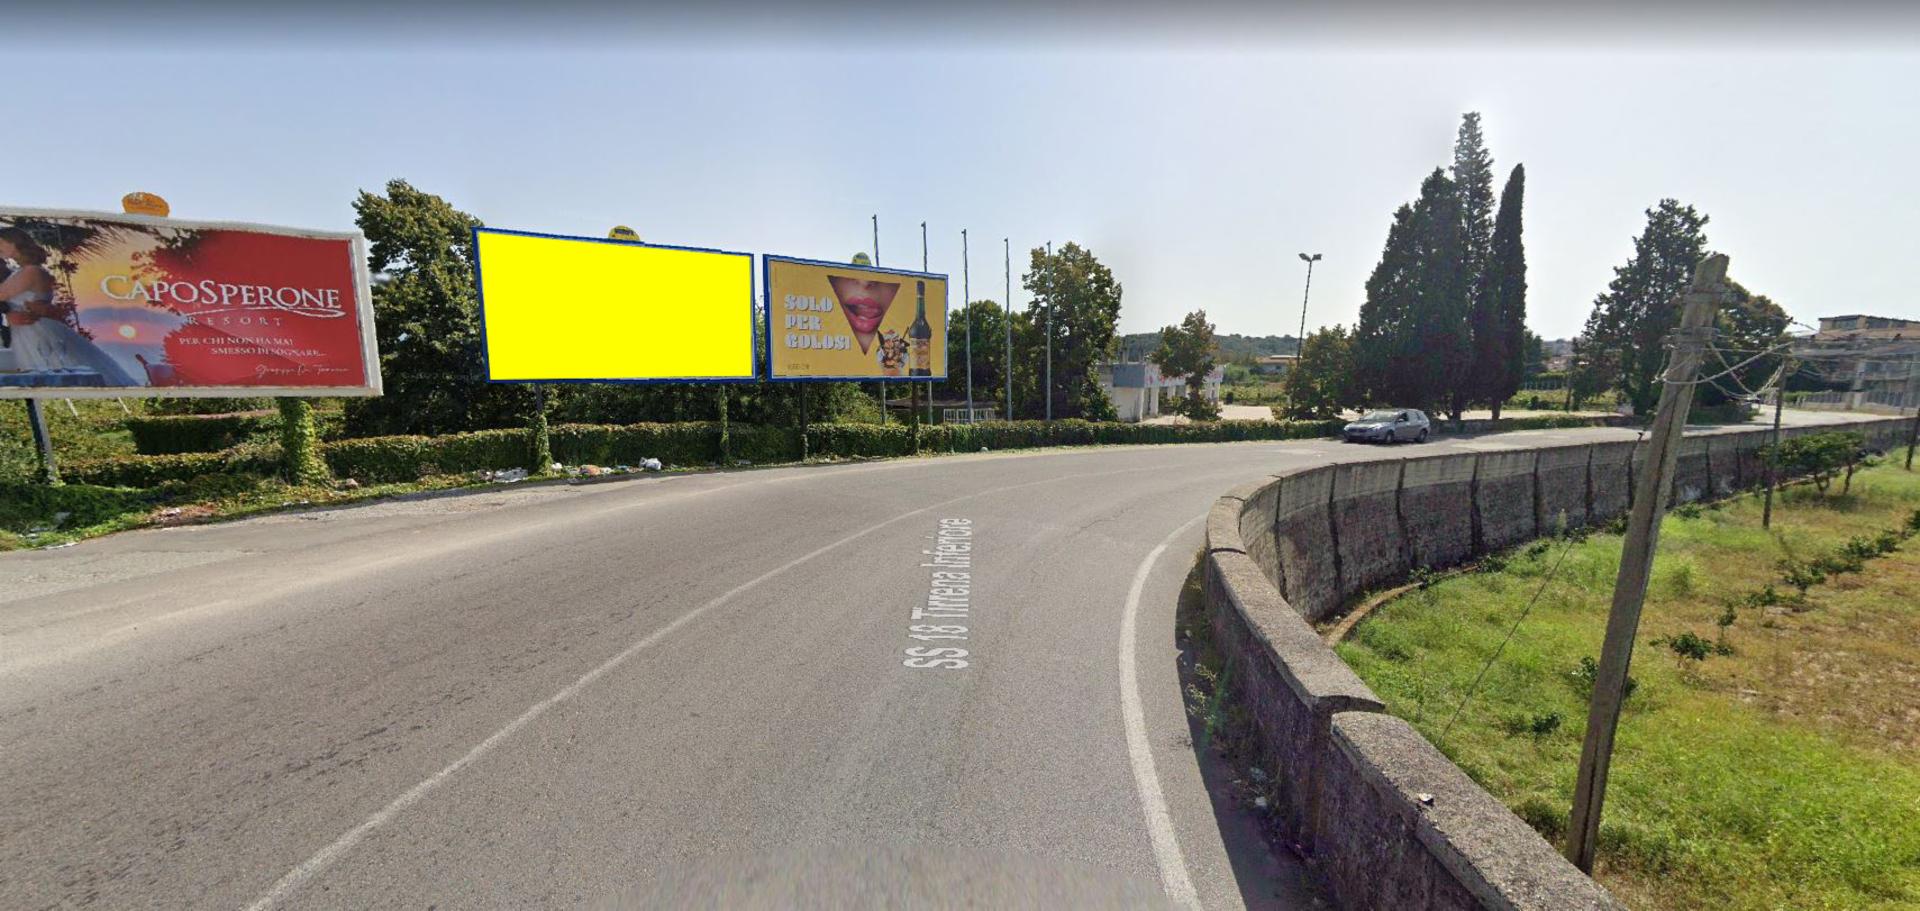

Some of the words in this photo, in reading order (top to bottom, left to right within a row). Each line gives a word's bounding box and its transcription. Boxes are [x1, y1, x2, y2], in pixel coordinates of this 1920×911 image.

[784, 294, 834, 312] SOLO
[187, 316, 283, 327] RESORT
[785, 313, 822, 331] PER
[178, 337, 201, 346] PER
[202, 337, 225, 346] CHI
[226, 337, 256, 346] NON
[785, 331, 852, 351] GOLOSI
[210, 347, 256, 356] SMESSO
